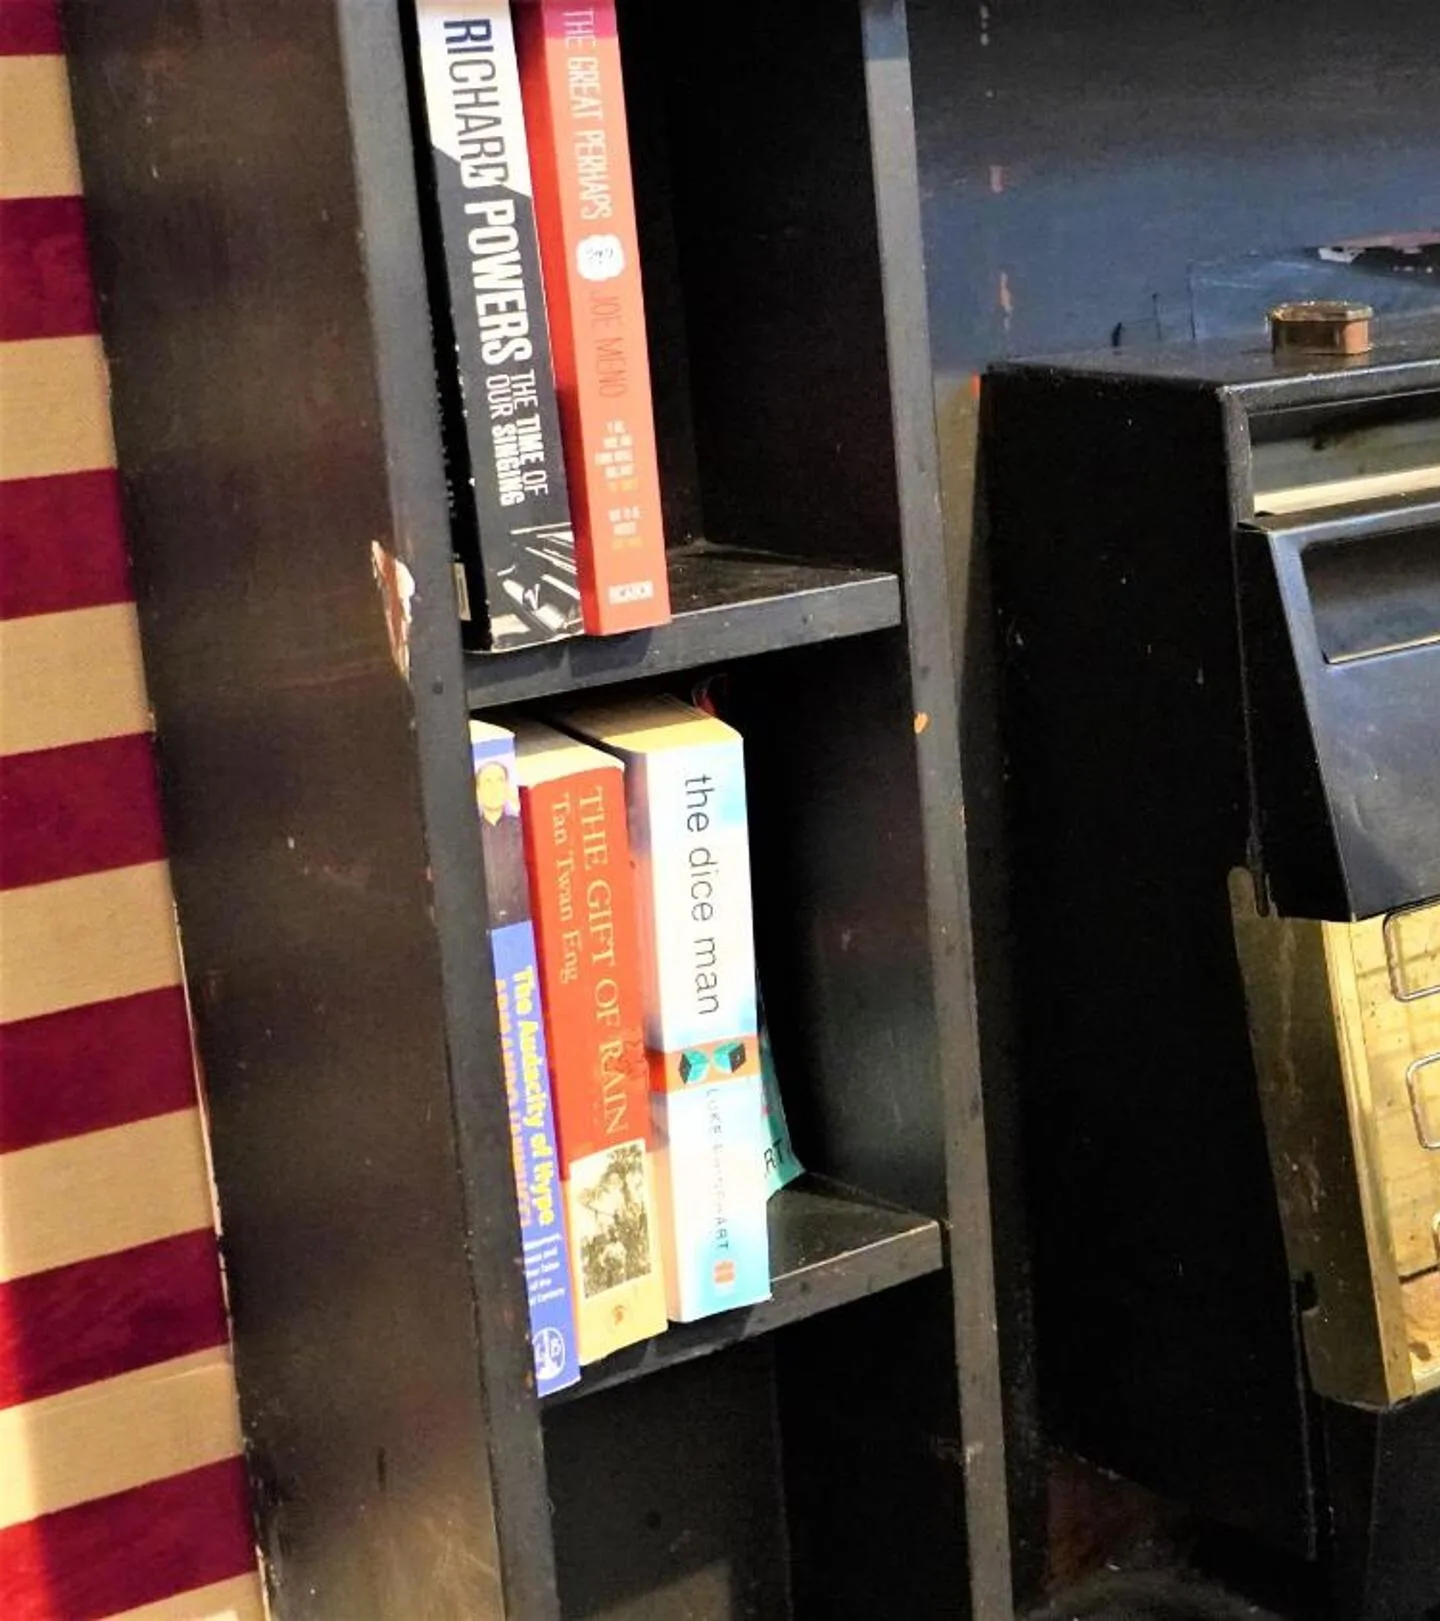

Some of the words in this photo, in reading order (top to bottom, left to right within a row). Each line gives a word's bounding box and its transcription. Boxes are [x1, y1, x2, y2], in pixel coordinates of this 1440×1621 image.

[561, 7, 597, 48] THE
[443, 18, 510, 189] RICHARD
[567, 56, 603, 120] GREAT
[573, 129, 613, 221] PERHAPS
[464, 199, 532, 365] POWERS
[589, 290, 622, 329] JOE
[486, 373, 514, 419] OUR
[510, 368, 538, 410] THE
[594, 337, 628, 397] MENO
[491, 423, 525, 507] SINGING
[517, 414, 546, 466] TIME
[523, 469, 549, 497] OF
[552, 792, 570, 846] Tan
[579, 786, 609, 871] THE
[685, 774, 716, 832] the
[556, 850, 576, 922] Twan
[688, 847, 719, 922] dice
[586, 879, 616, 968] GIFT
[560, 930, 582, 984] Eng
[693, 935, 720, 1015] man
[513, 965, 535, 1015] The
[595, 978, 622, 1028] OF
[518, 1020, 548, 1129] Audacity
[599, 1038, 629, 1135] RAIN
[529, 1132, 553, 1159] of
[530, 1160, 555, 1226] Hype
